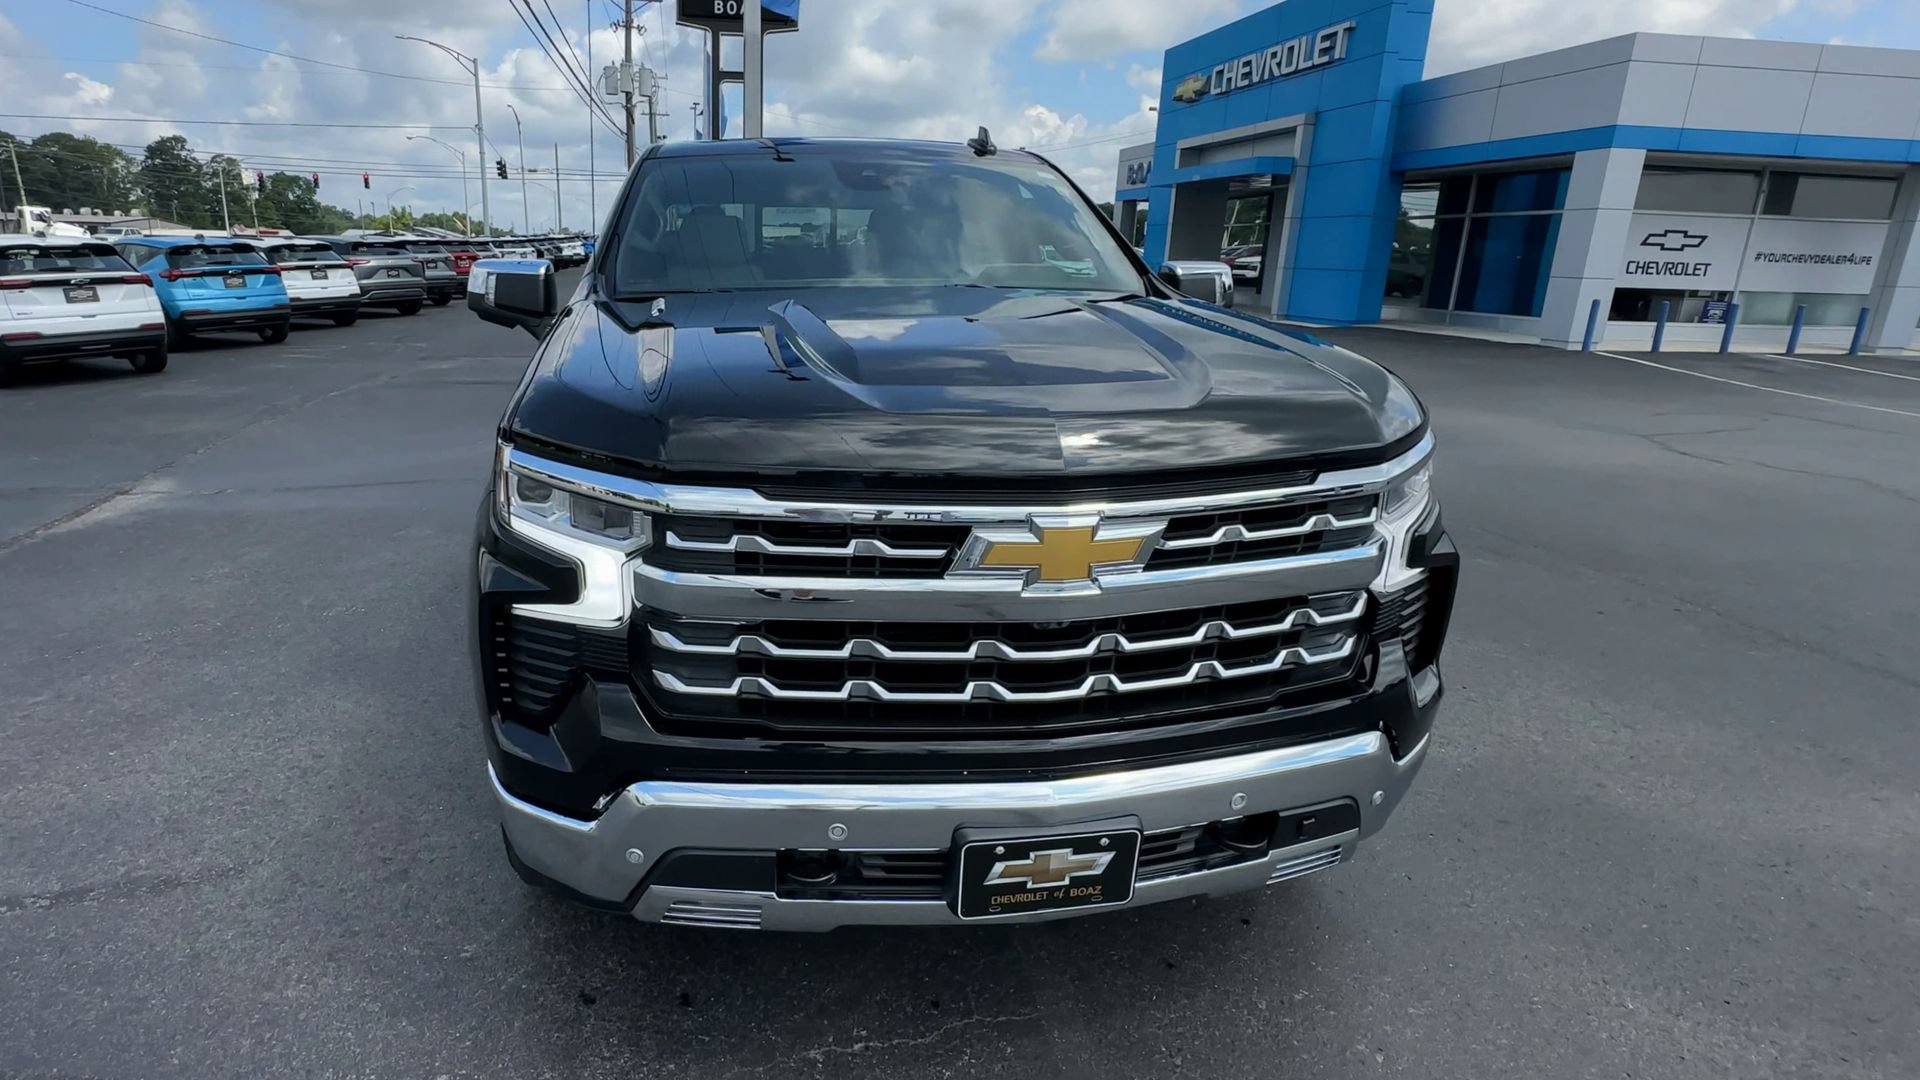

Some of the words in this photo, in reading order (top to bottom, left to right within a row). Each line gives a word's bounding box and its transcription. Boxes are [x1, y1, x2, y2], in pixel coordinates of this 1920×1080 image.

[1210, 21, 1355, 95] CHEVROLET
[1754, 251, 1872, 266] #YOURCHEVYDEALER4LIFE
[1625, 260, 1711, 277] CHEVROLET
[991, 891, 1049, 905] CHEVROLET
[1054, 888, 1066, 899] of
[1069, 886, 1102, 897] BOAZ
